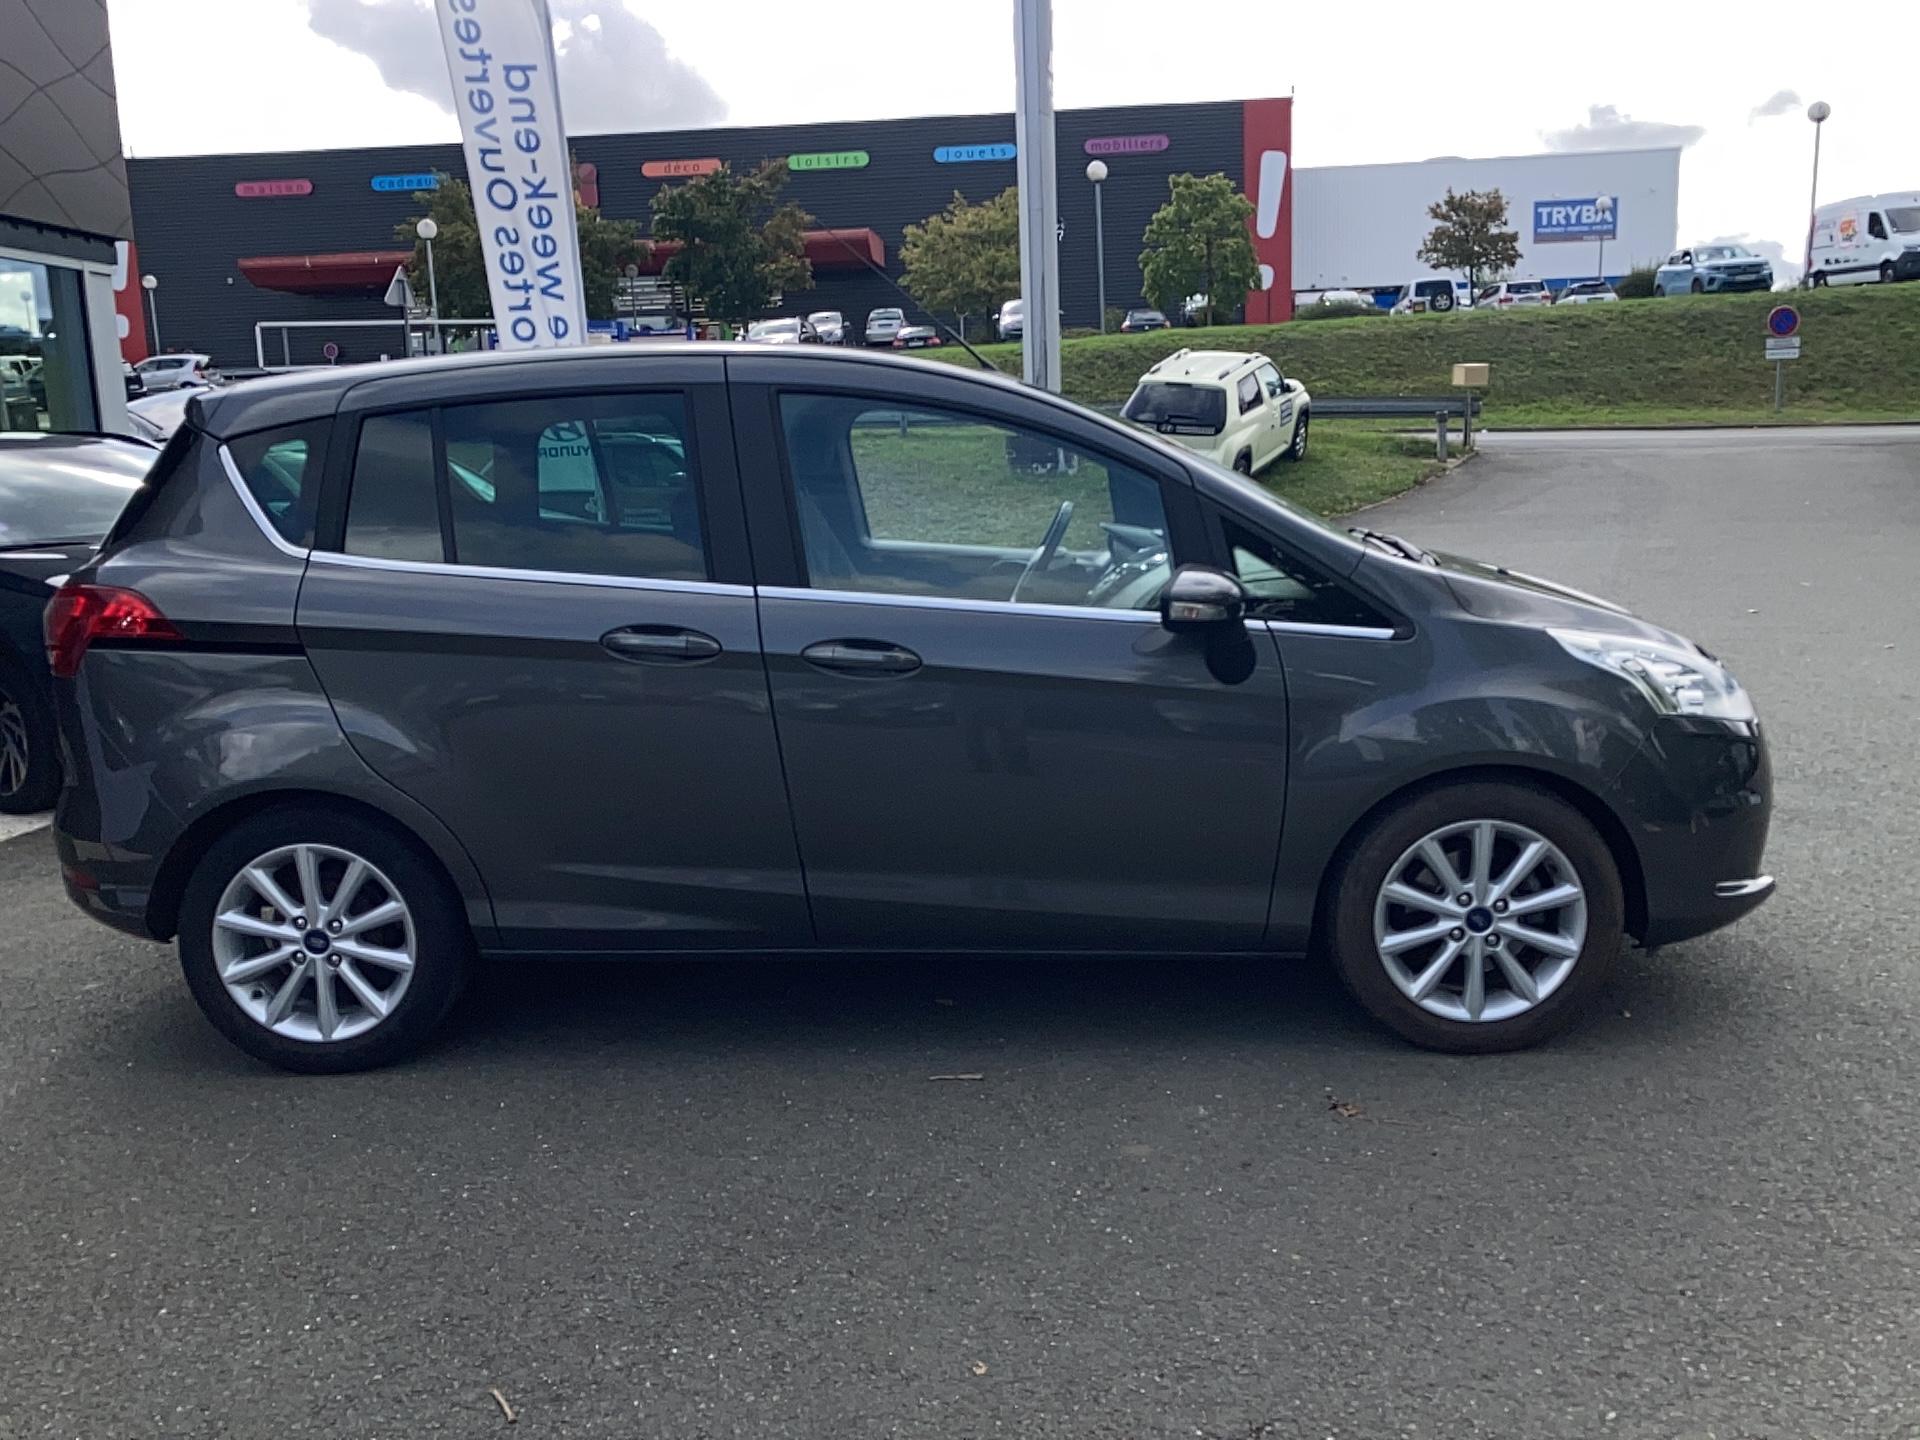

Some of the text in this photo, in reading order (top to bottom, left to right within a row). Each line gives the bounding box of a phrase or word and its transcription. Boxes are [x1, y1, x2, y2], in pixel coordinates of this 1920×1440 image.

[1090, 139, 1164, 151] mobiliers
[945, 147, 1007, 161] jouets
[663, 161, 700, 174] déco
[796, 155, 860, 168] loisirs
[242, 183, 305, 195] maison
